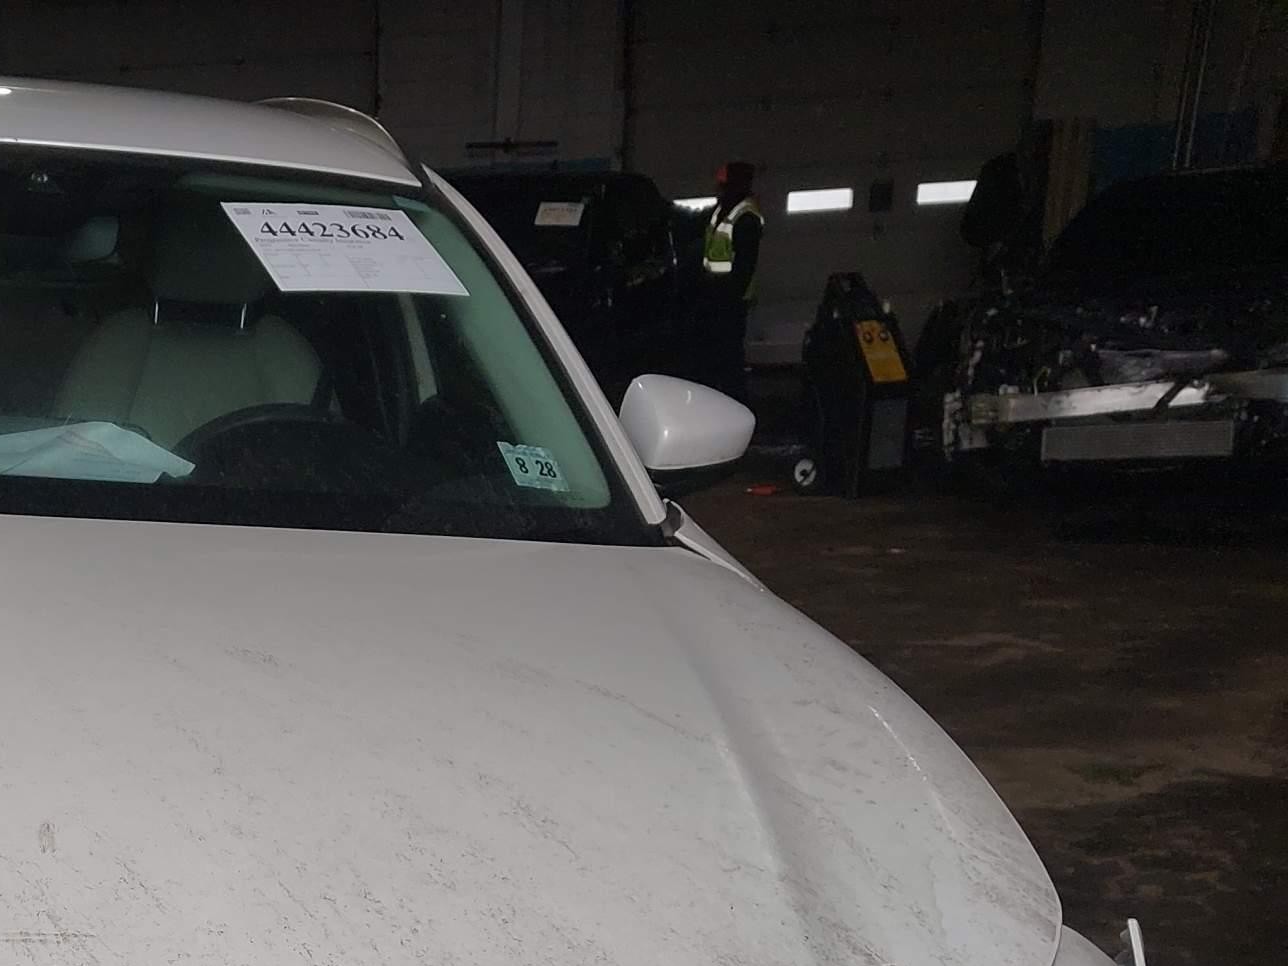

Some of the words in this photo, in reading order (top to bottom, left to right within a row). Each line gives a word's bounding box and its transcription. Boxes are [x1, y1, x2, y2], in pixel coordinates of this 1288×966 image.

[260, 221, 404, 241] 44423684
[515, 457, 529, 474] 8
[535, 460, 557, 478] 28
